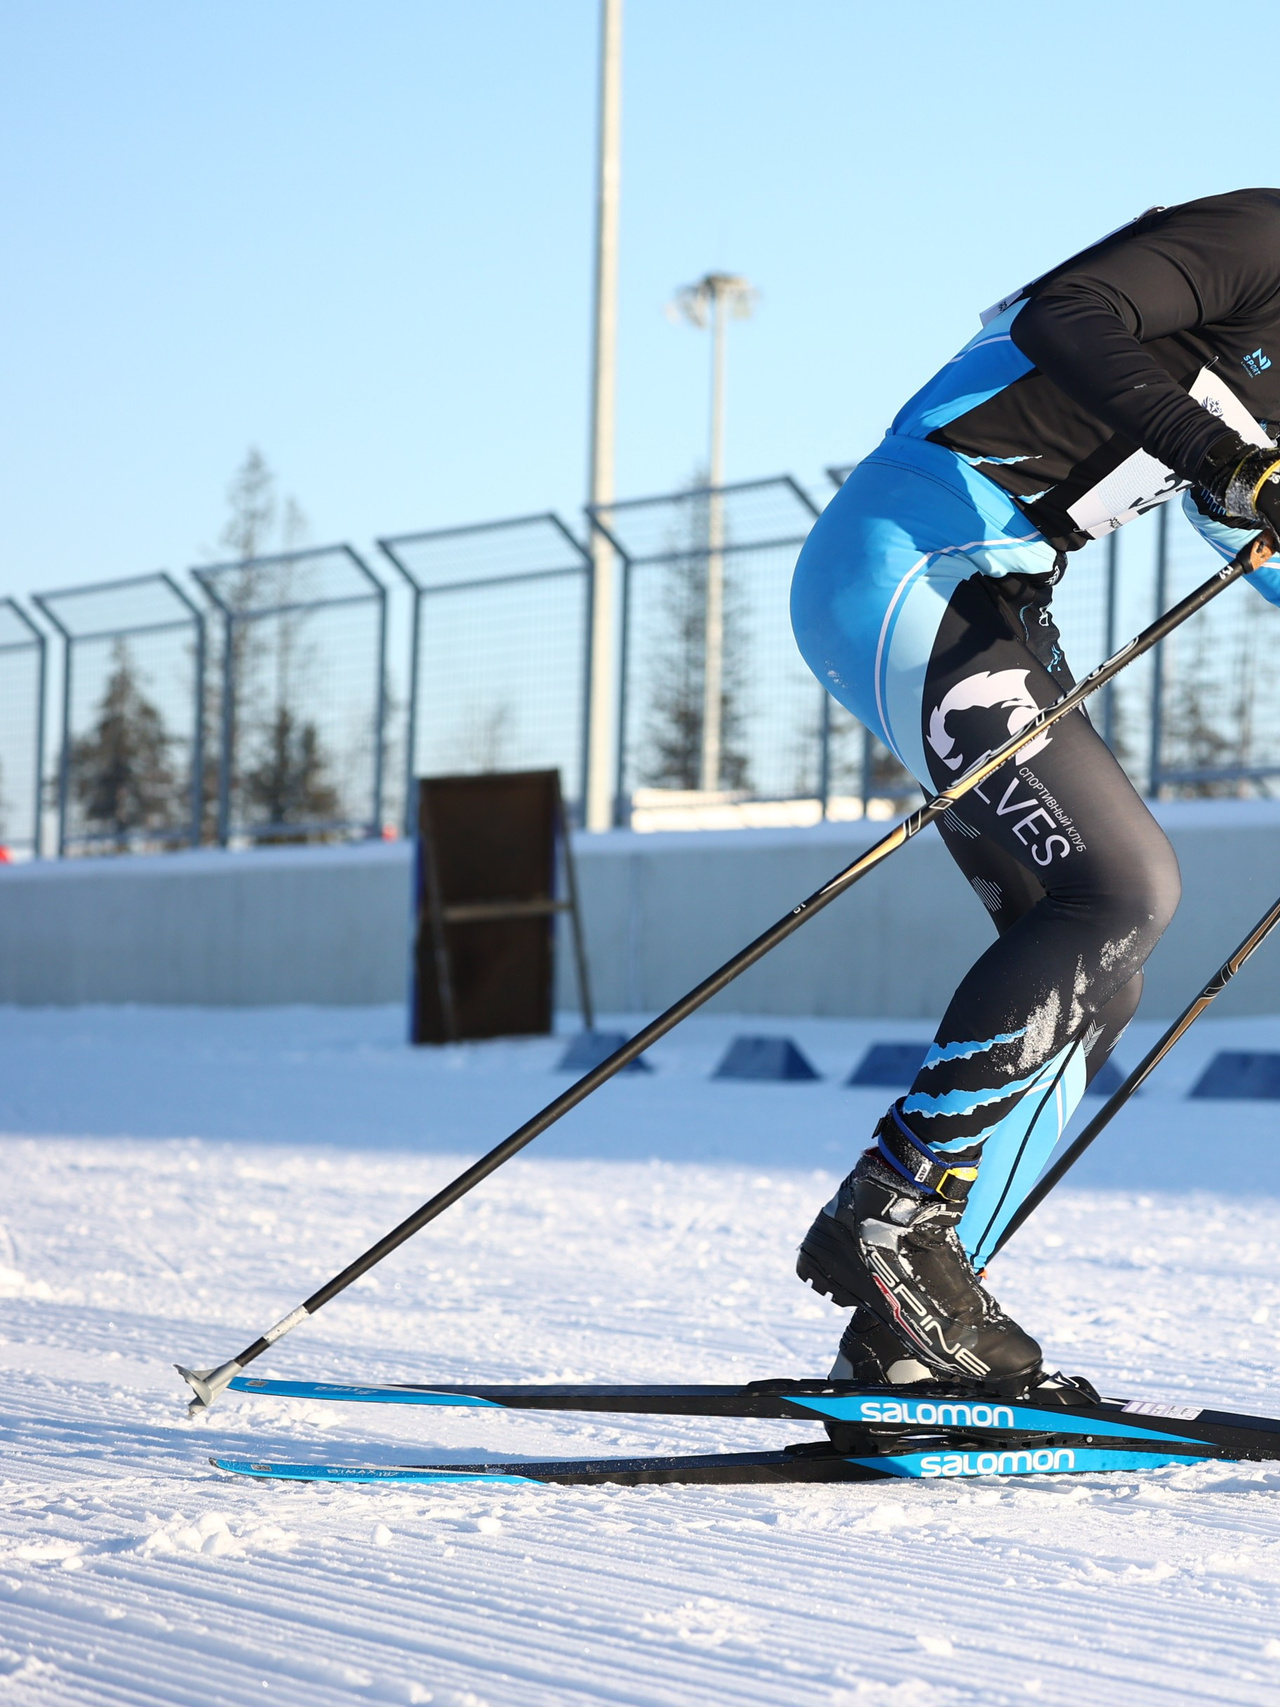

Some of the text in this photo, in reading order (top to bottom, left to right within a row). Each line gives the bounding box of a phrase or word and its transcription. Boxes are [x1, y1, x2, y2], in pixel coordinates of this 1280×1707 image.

[961, 752, 1071, 867] LVES
[1018, 766, 1073, 828] СПОРТИВНЫЙ
[1065, 826, 1087, 853] КЛУБ
[867, 1250, 992, 1378] SPINE
[860, 1402, 1014, 1427] salomon
[920, 1449, 1075, 1478] salomon
